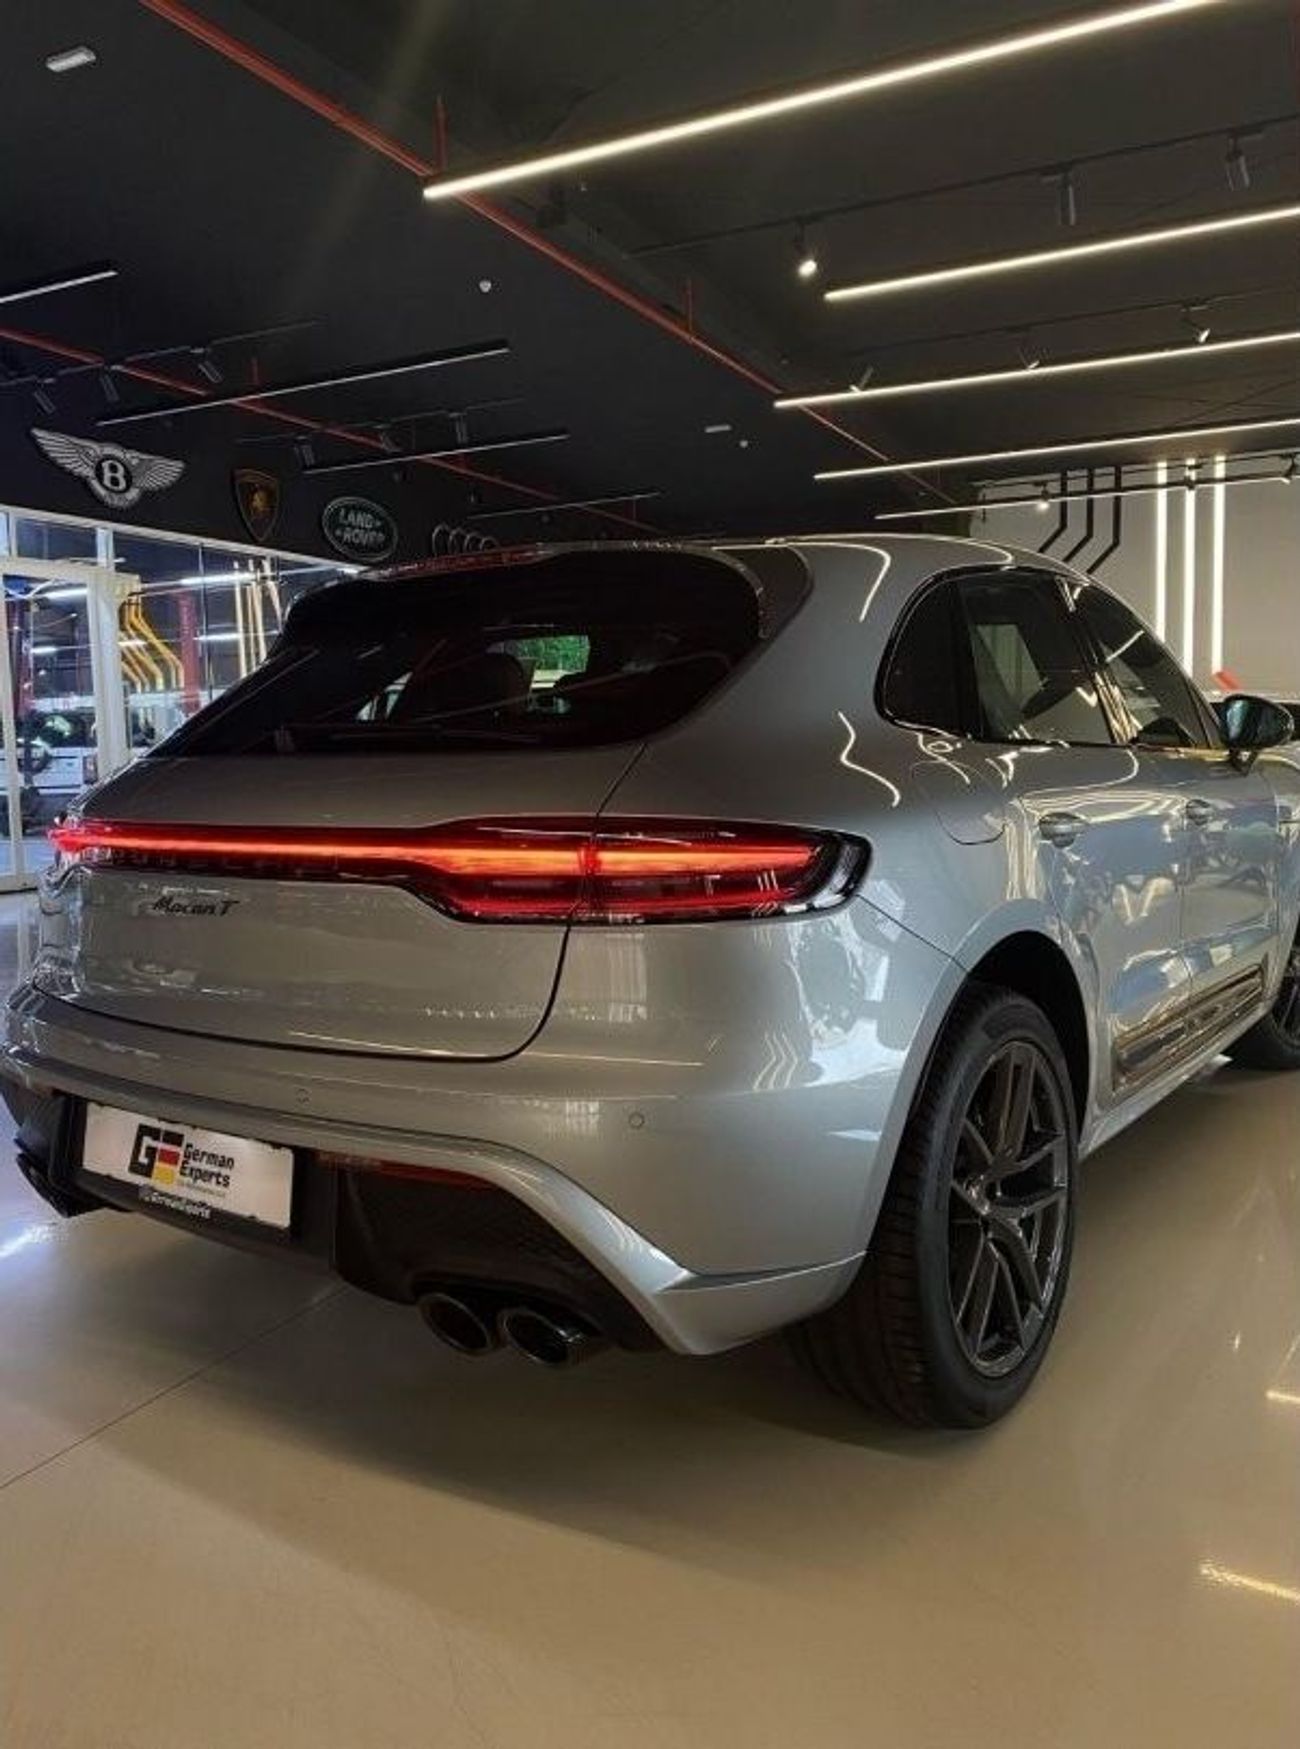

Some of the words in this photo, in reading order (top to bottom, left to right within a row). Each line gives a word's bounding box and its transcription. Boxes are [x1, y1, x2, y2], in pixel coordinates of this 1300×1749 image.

[339, 508, 373, 528] LAND
[220, 899, 240, 916] T
[184, 1142, 235, 1171] German
[179, 1160, 231, 1188] Experts
